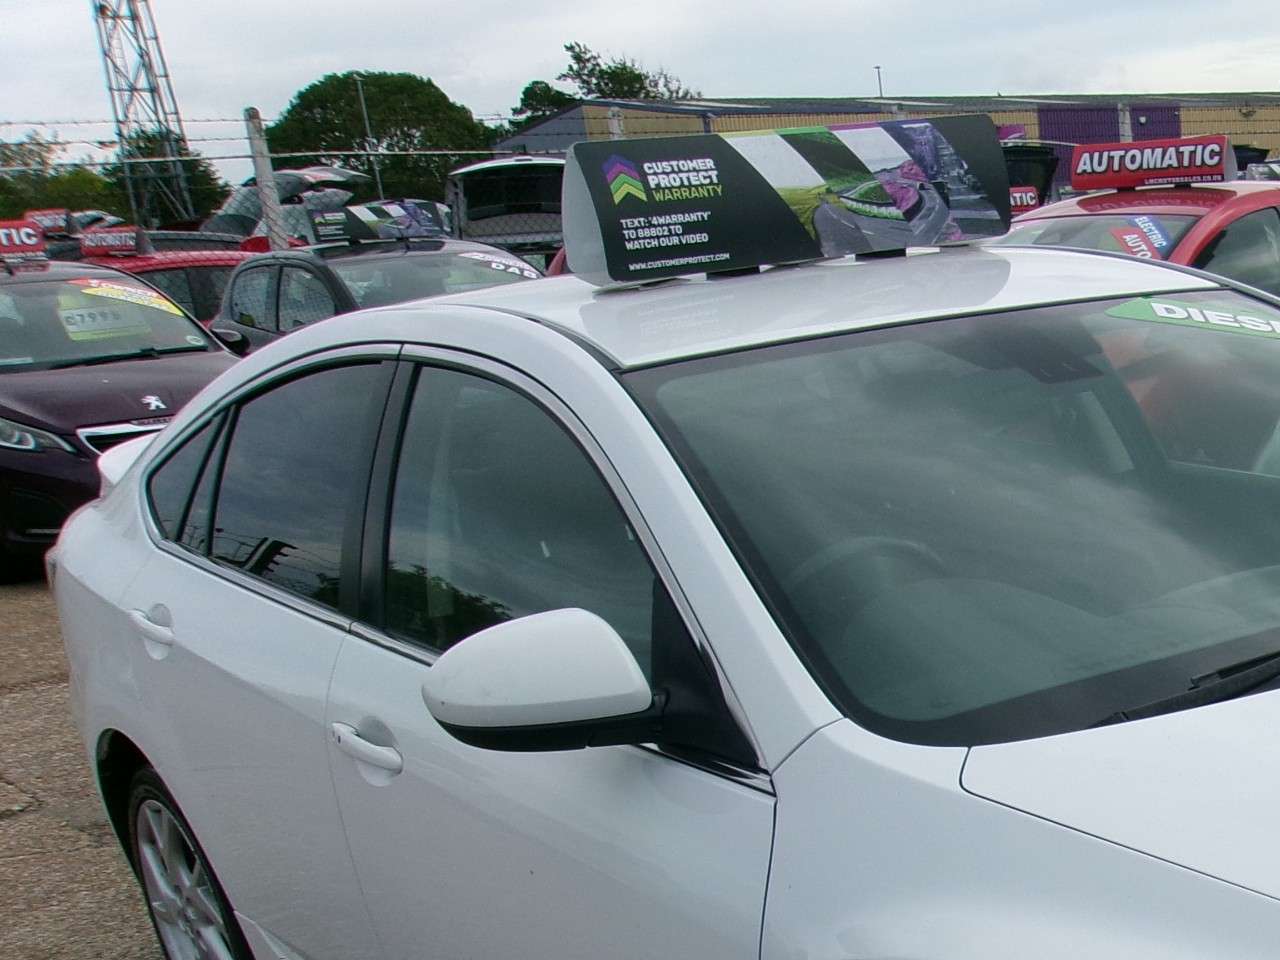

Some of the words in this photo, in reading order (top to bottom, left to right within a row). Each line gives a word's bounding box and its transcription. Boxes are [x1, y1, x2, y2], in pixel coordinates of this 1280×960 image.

[643, 158, 716, 174] CUSTOMER
[1076, 143, 1222, 175] AUTOMATIC
[647, 170, 718, 189] PROTECT
[652, 184, 722, 202] WARRANTY
[620, 218, 649, 229] TEXT:
[622, 230, 637, 240] TO
[637, 227, 670, 239] 88802
[671, 225, 683, 236] TO
[1134, 216, 1168, 249] ELECTRIC
[624, 238, 659, 251] WATCH
[660, 235, 680, 247] OUR
[681, 233, 709, 245] VIDEO
[1122, 233, 1153, 259] AUTO
[491, 262, 537, 279] DAB
[628, 252, 730, 271] WWW.CUSTOMERPROTECT.COM
